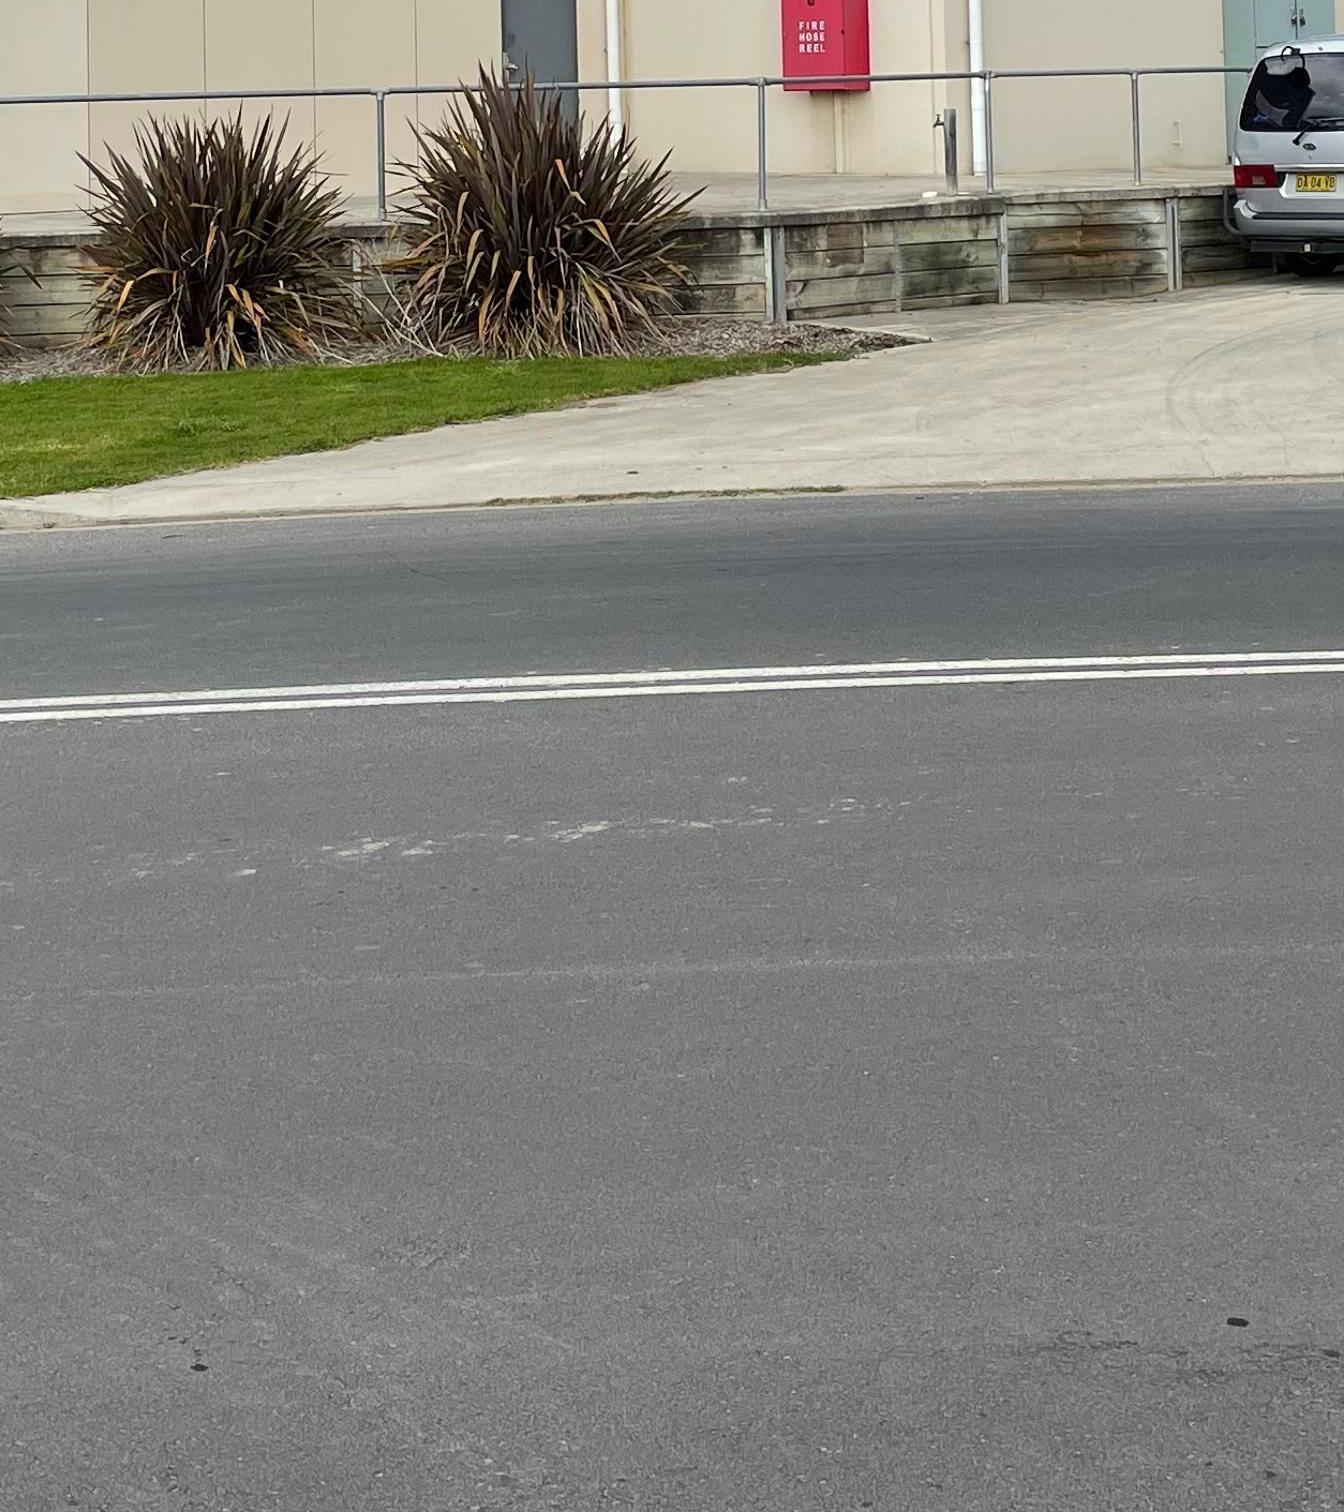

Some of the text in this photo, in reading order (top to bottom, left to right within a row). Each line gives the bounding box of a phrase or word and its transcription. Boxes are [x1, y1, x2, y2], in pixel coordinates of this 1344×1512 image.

[798, 20, 826, 31] FIRE
[798, 31, 826, 42] HOSE
[798, 43, 826, 53] REEL
